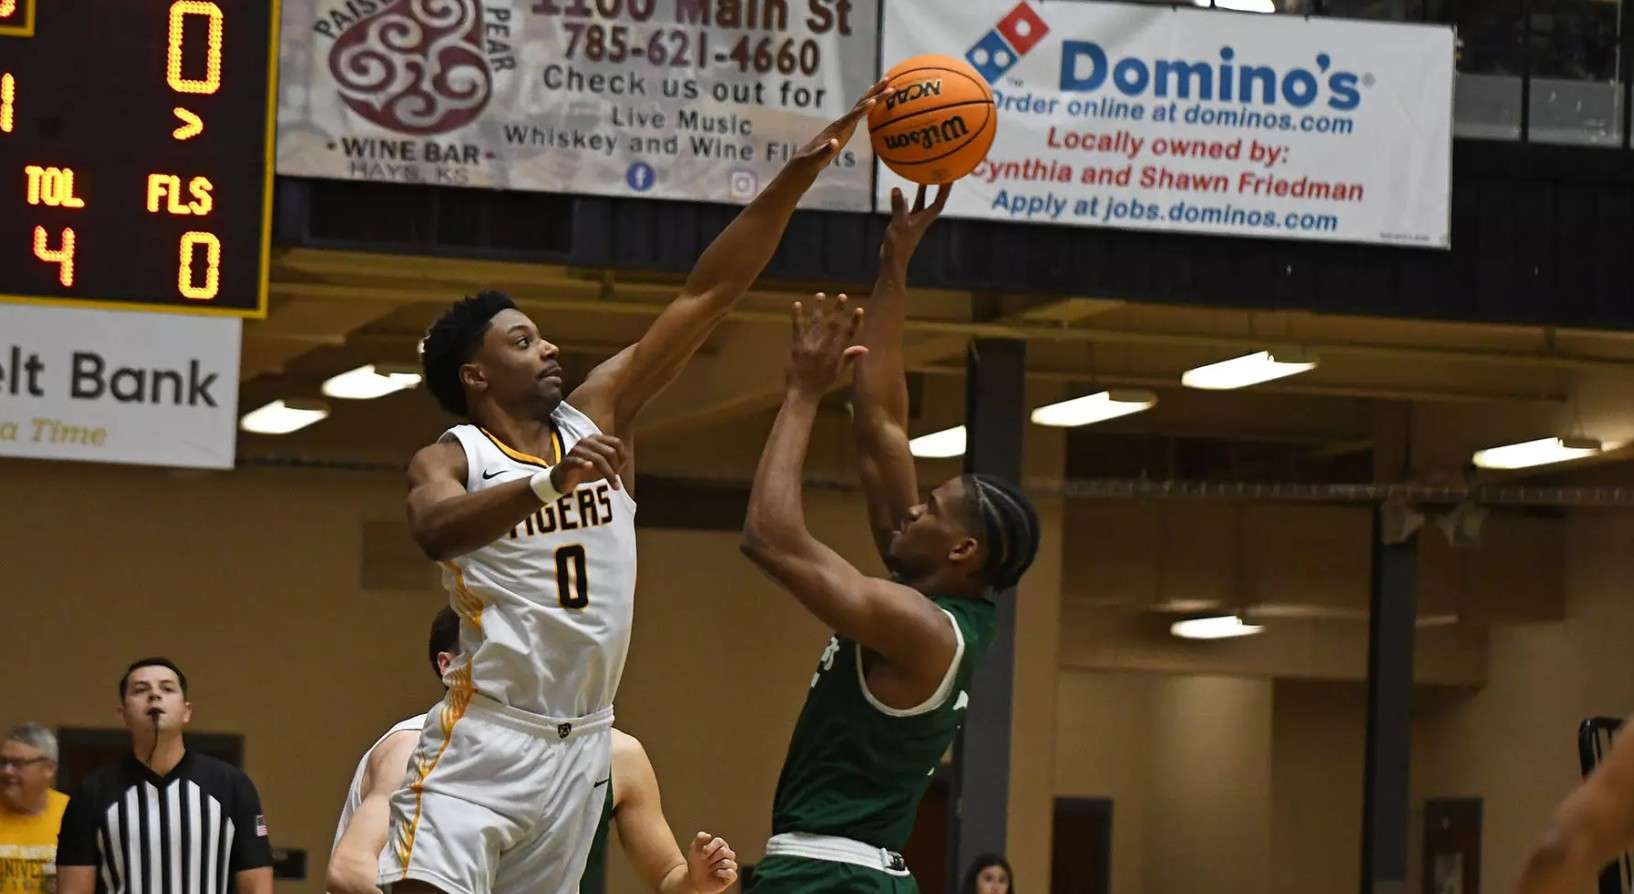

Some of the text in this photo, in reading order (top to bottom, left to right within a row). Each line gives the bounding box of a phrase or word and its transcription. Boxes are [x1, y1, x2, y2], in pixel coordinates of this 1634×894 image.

[675, 0, 788, 31] Main
[806, 0, 852, 35] St
[167, 1, 223, 94] 0
[486, 7, 517, 72] PEAR
[563, 22, 822, 77] 785-621-4660
[543, 64, 827, 108] Check us out for
[1059, 40, 1360, 111] Domino's
[611, 106, 753, 135] Live Music
[883, 115, 969, 149] Wilson
[1067, 99, 1145, 121] online
[1152, 101, 1177, 123] at
[1185, 103, 1354, 134] dominos.com
[341, 137, 481, 165] WINE BAR
[503, 125, 618, 156] Whiskey
[629, 136, 678, 154] and
[690, 136, 754, 161] Wine
[1046, 127, 1290, 167] Locally owned by:
[25, 165, 84, 208] TOL
[147, 174, 213, 215] FLS
[1081, 165, 1132, 187] and
[1140, 166, 1229, 193] Shawn
[1238, 172, 1365, 202] Friedman
[991, 189, 1338, 233] Apply at jobs.dominos.com
[34, 225, 75, 286] 4
[179, 231, 220, 299] 0
[0, 345, 219, 407] lt Bank
[0, 417, 107, 446] a Time
[555, 543, 589, 609] 0
